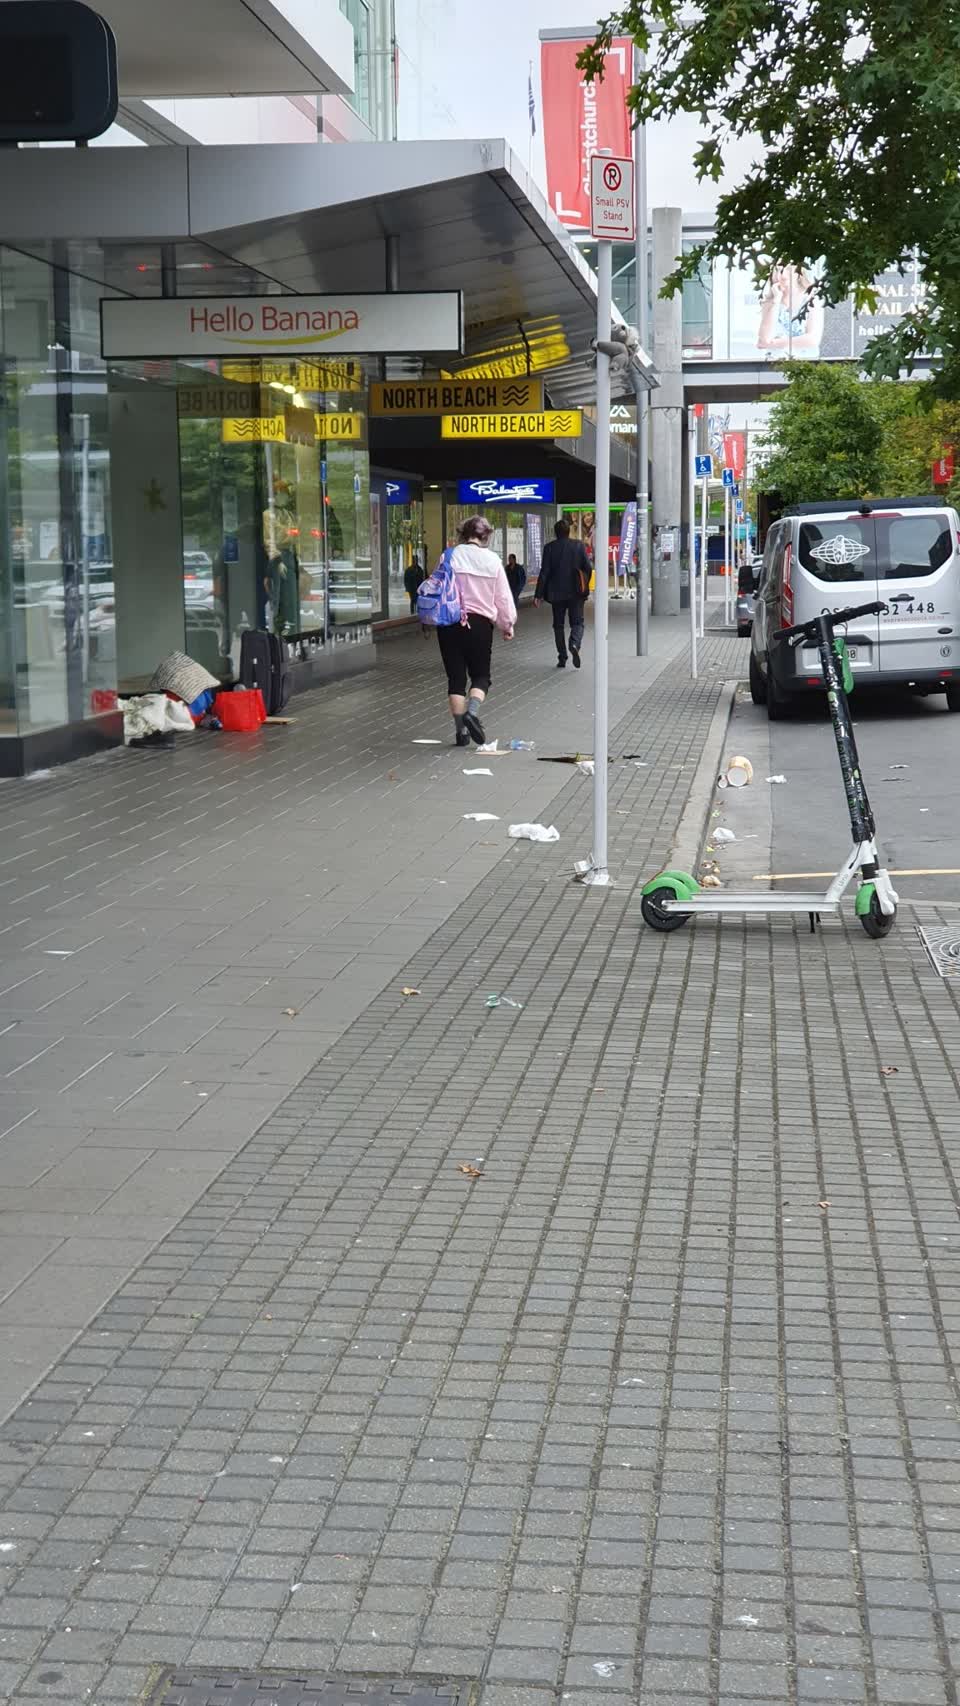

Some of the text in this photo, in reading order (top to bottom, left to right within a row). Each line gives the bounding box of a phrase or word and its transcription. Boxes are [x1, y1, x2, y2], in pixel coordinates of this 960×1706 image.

[595, 195, 630, 209] Small PSV
[603, 210, 623, 221] Stand
[190, 306, 359, 333] Hello Banana
[383, 386, 497, 409] NORTH BEACH
[451, 415, 545, 433] NORTH BEACH
[905, 602, 935, 615] 448
